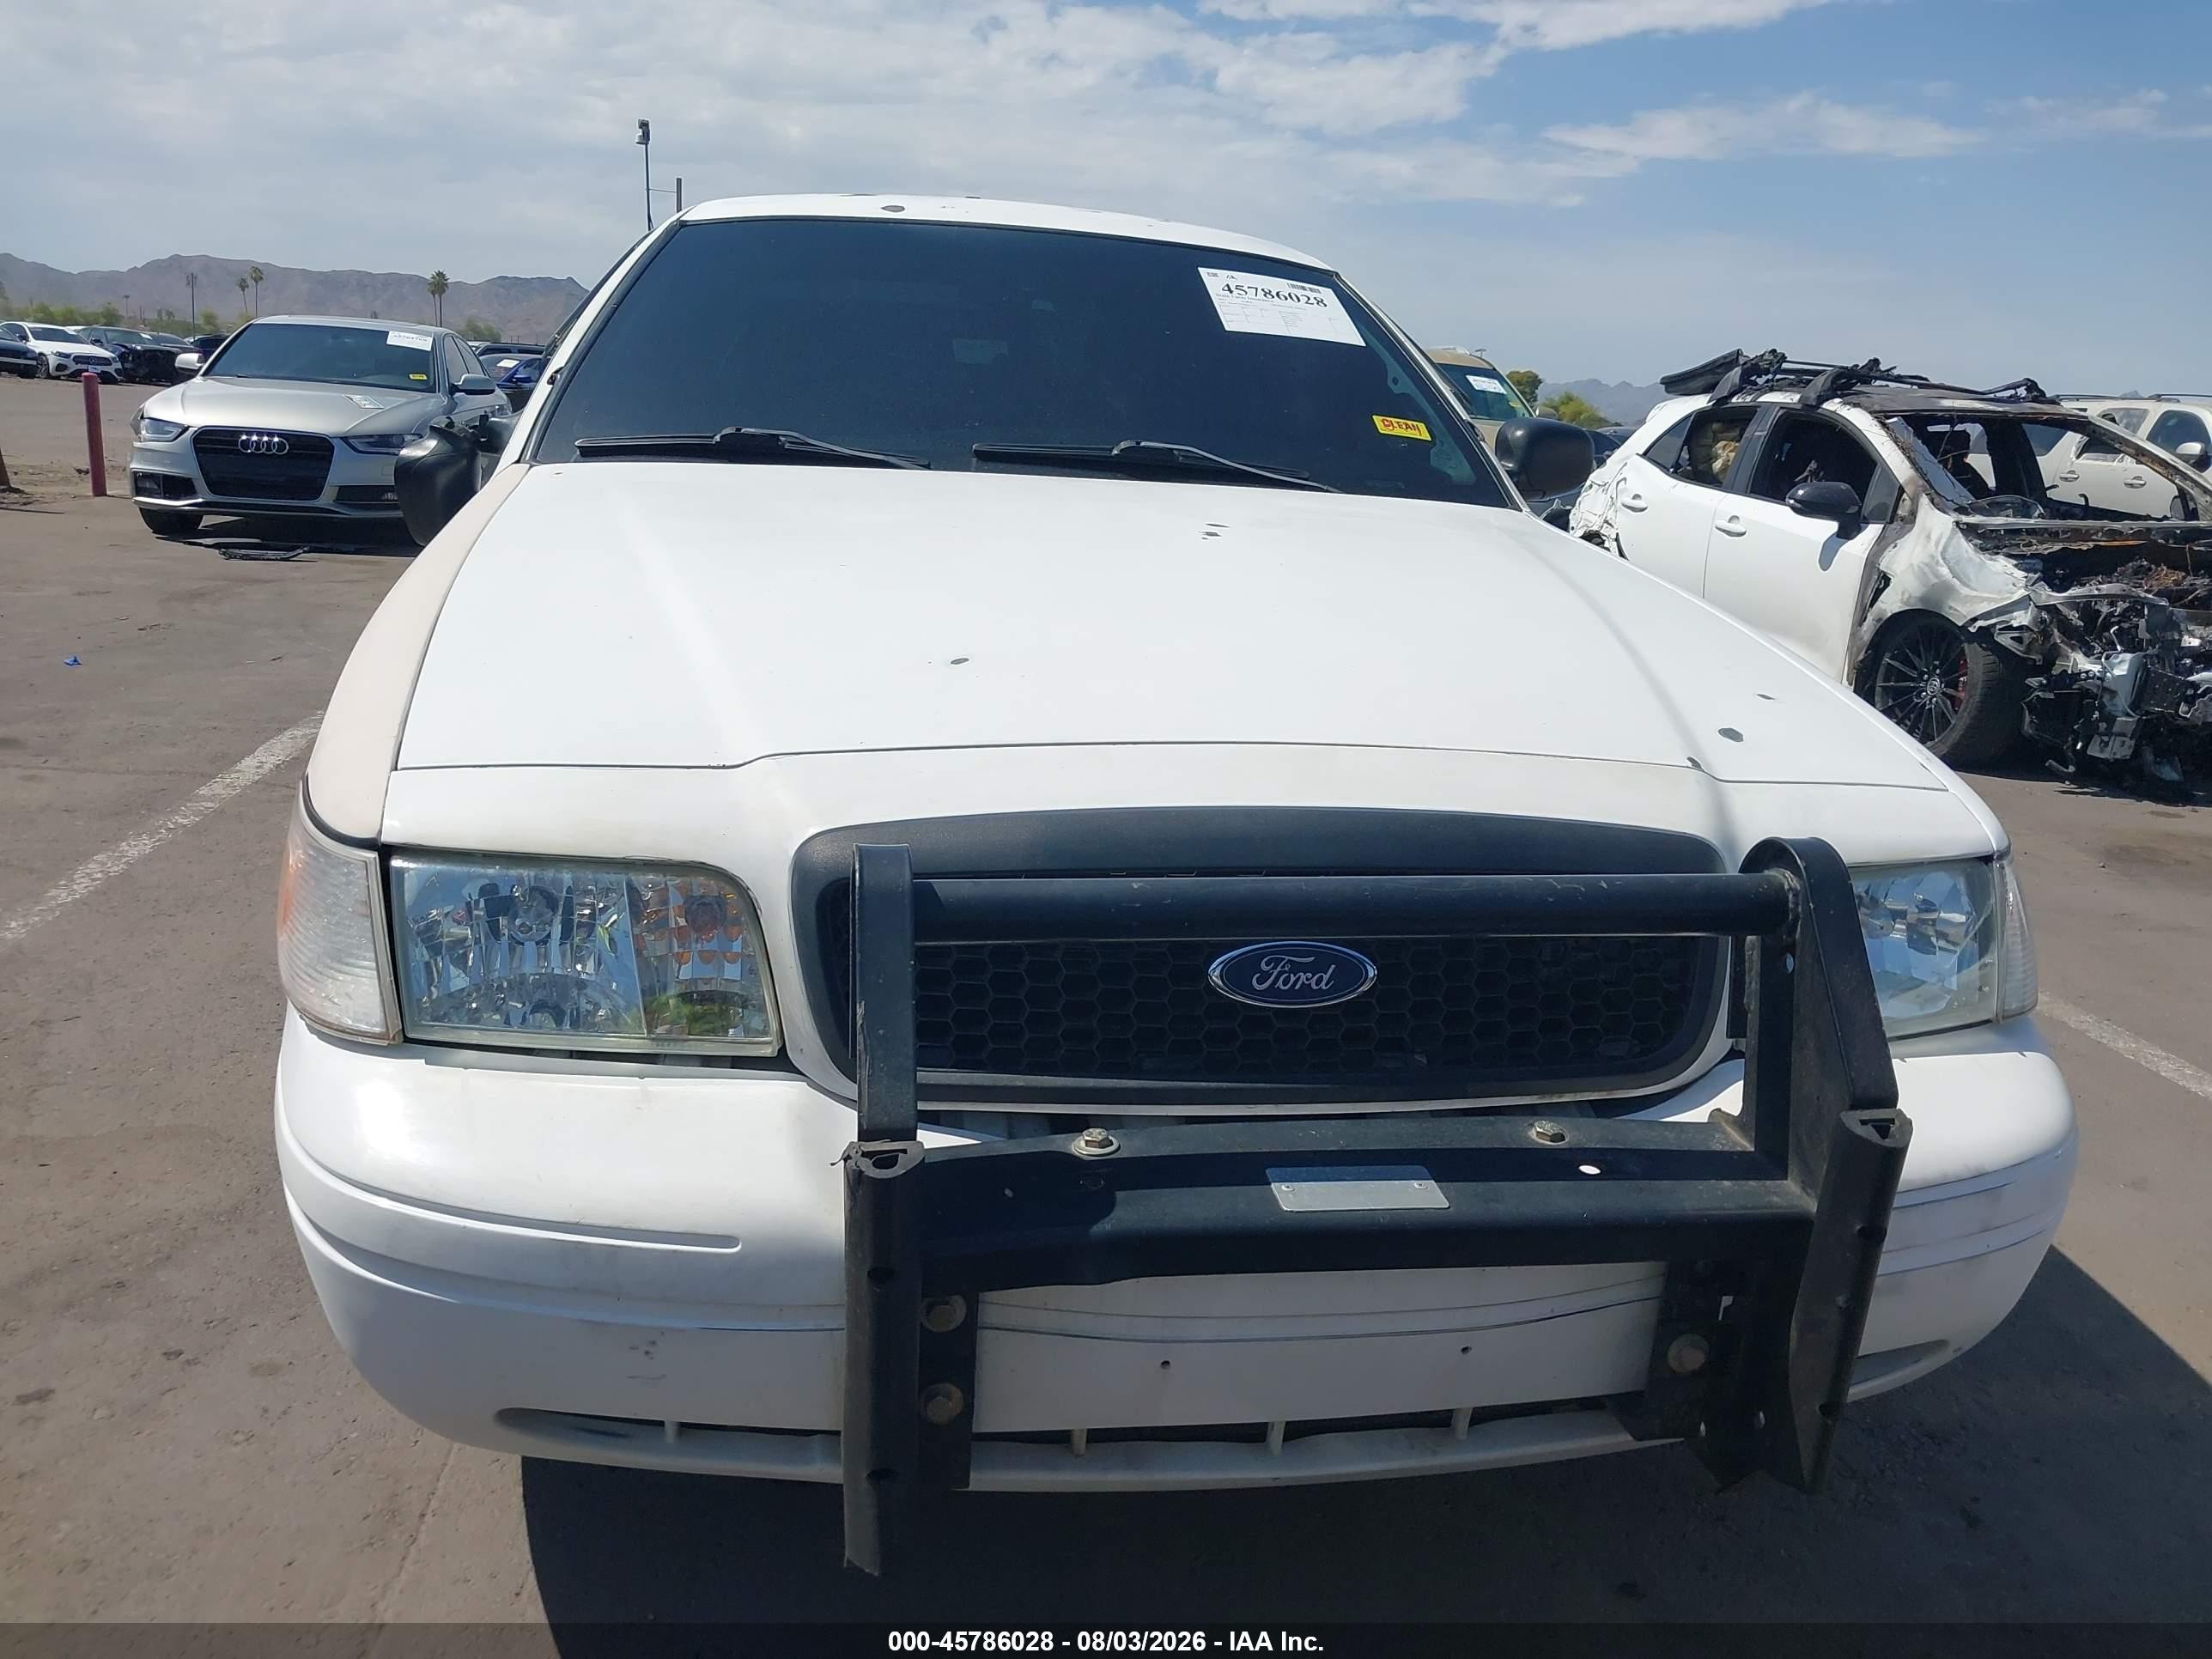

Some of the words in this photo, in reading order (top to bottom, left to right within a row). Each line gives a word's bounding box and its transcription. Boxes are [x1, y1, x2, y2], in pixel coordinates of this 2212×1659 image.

[1221, 283, 1328, 307] 45786028
[1381, 418, 1422, 436] CLEAN
[1251, 955, 1336, 990] Ford
